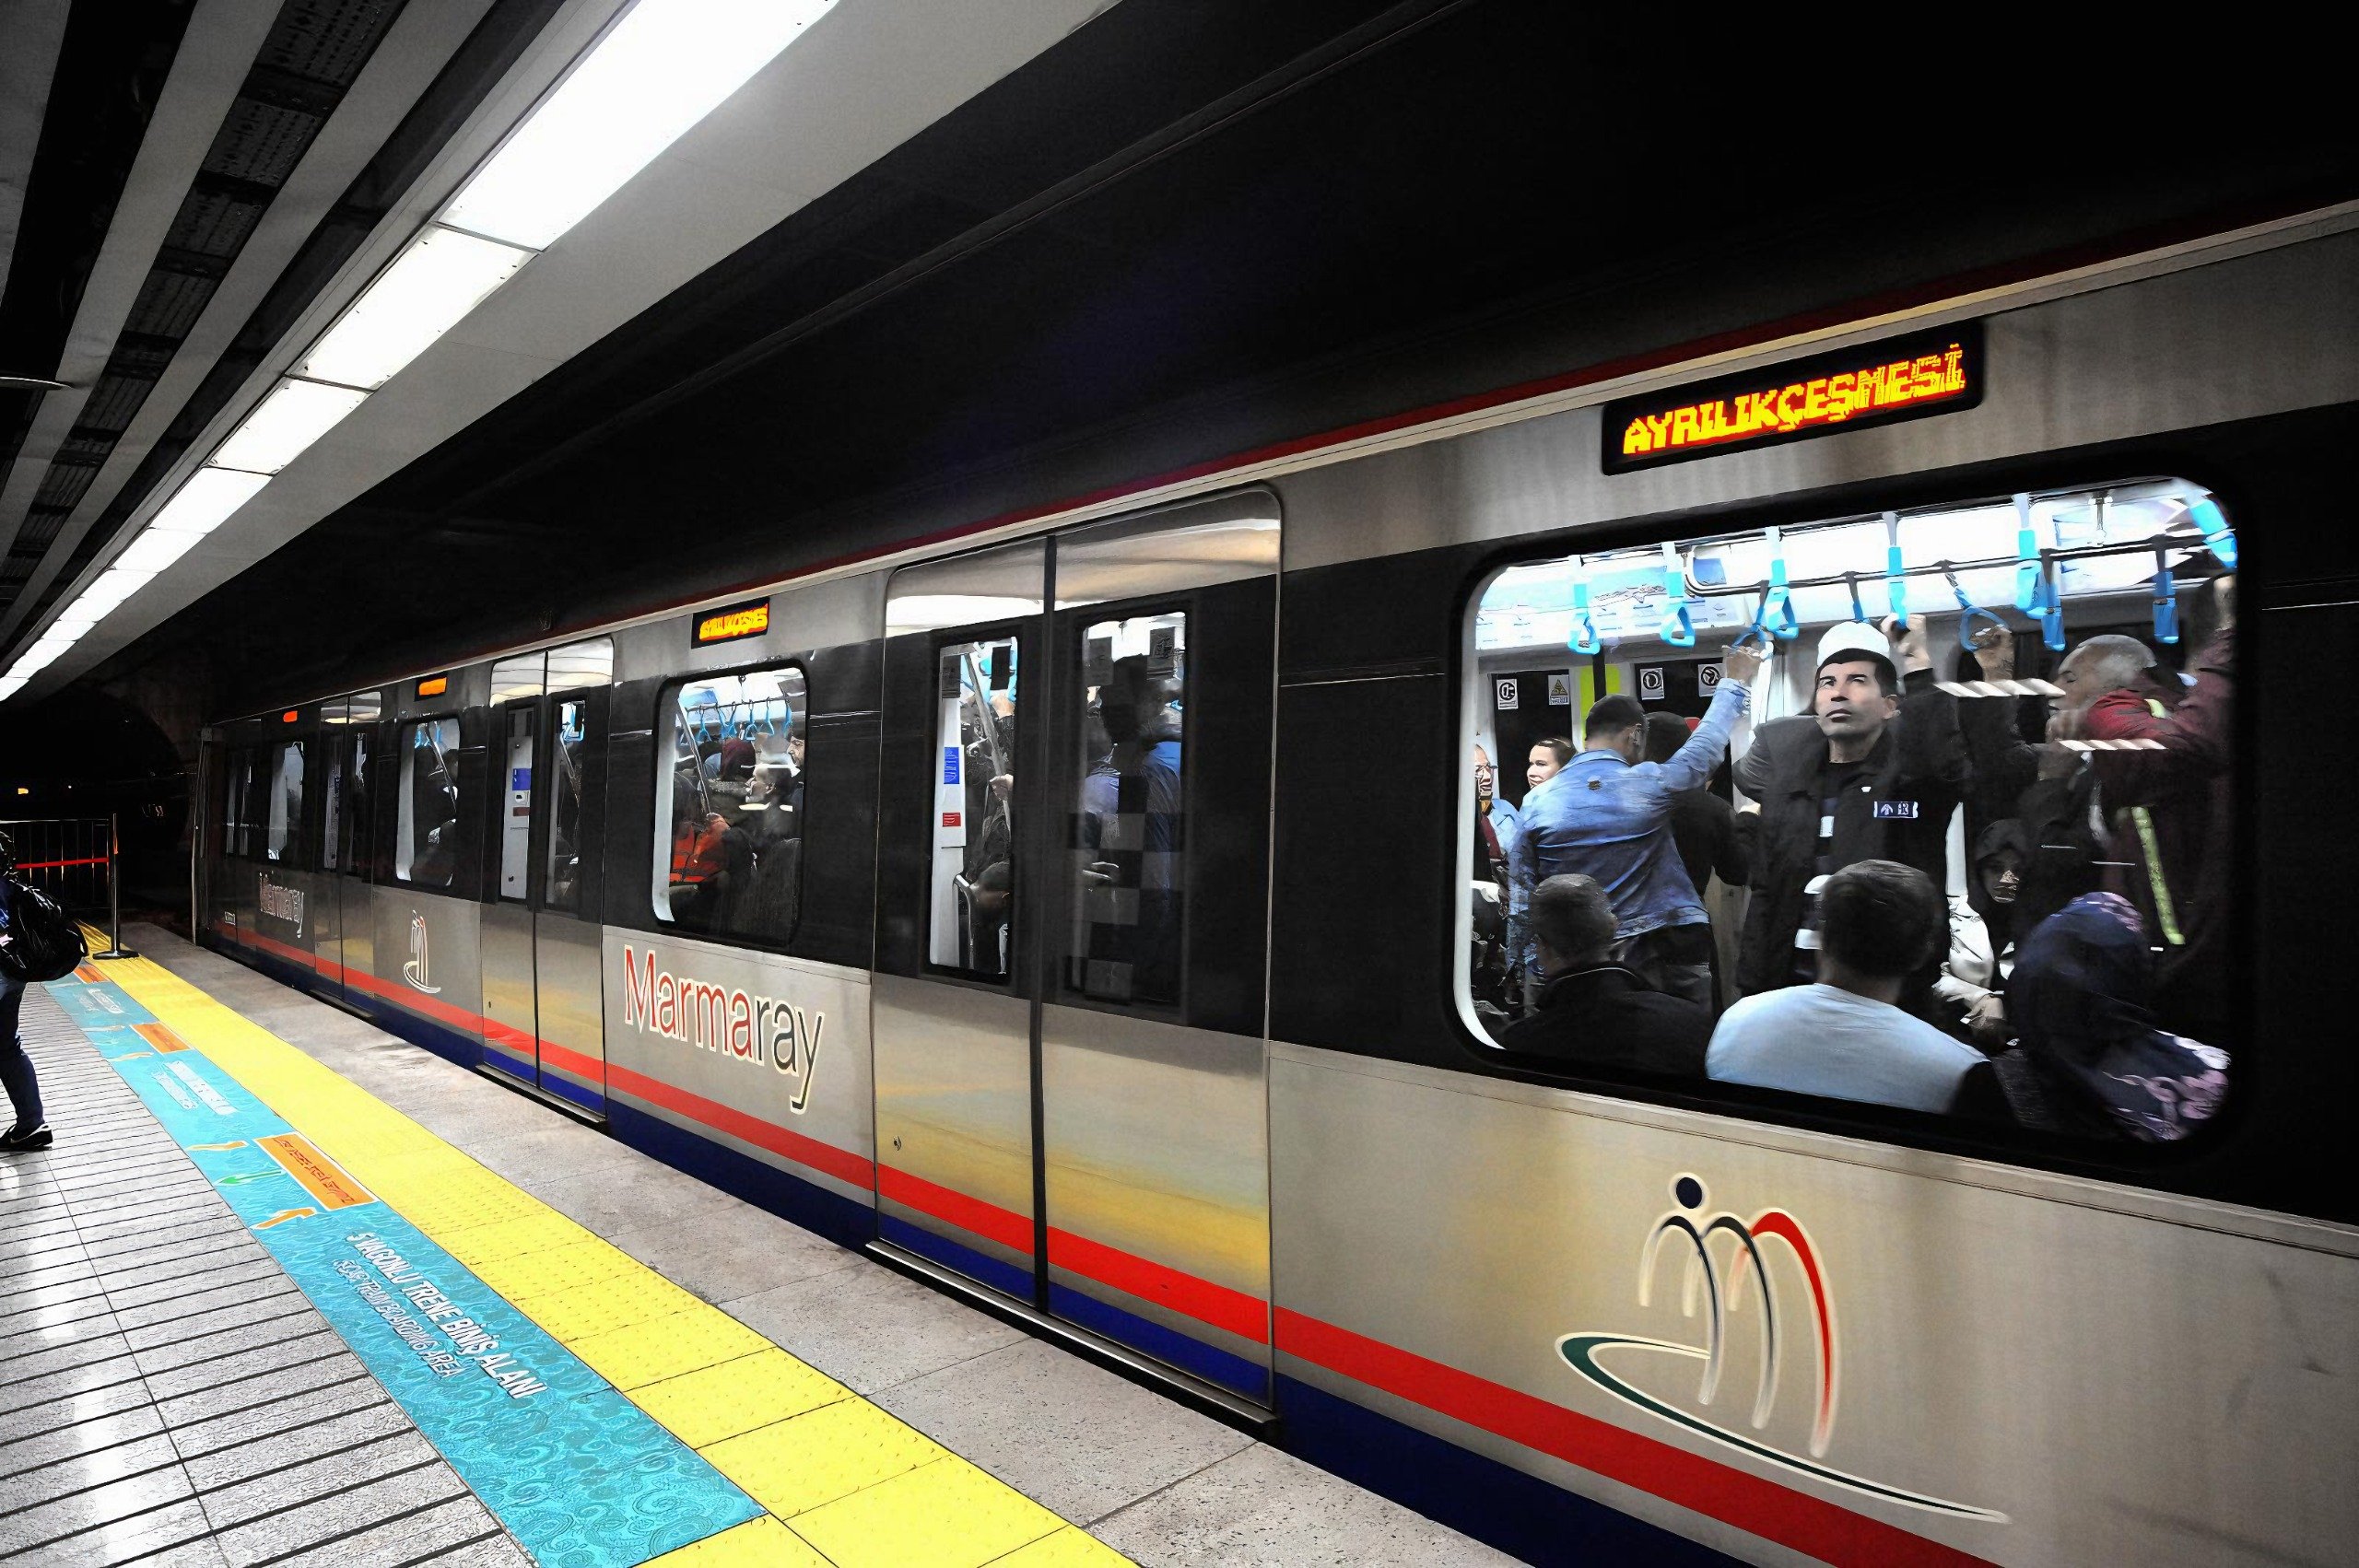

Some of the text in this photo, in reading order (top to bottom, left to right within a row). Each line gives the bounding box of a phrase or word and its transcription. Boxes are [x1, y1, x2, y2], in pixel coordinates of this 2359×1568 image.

[624, 943, 826, 1115] Marmaray
[401, 1280, 464, 1322] TRENE
[417, 1349, 468, 1378] AREA
